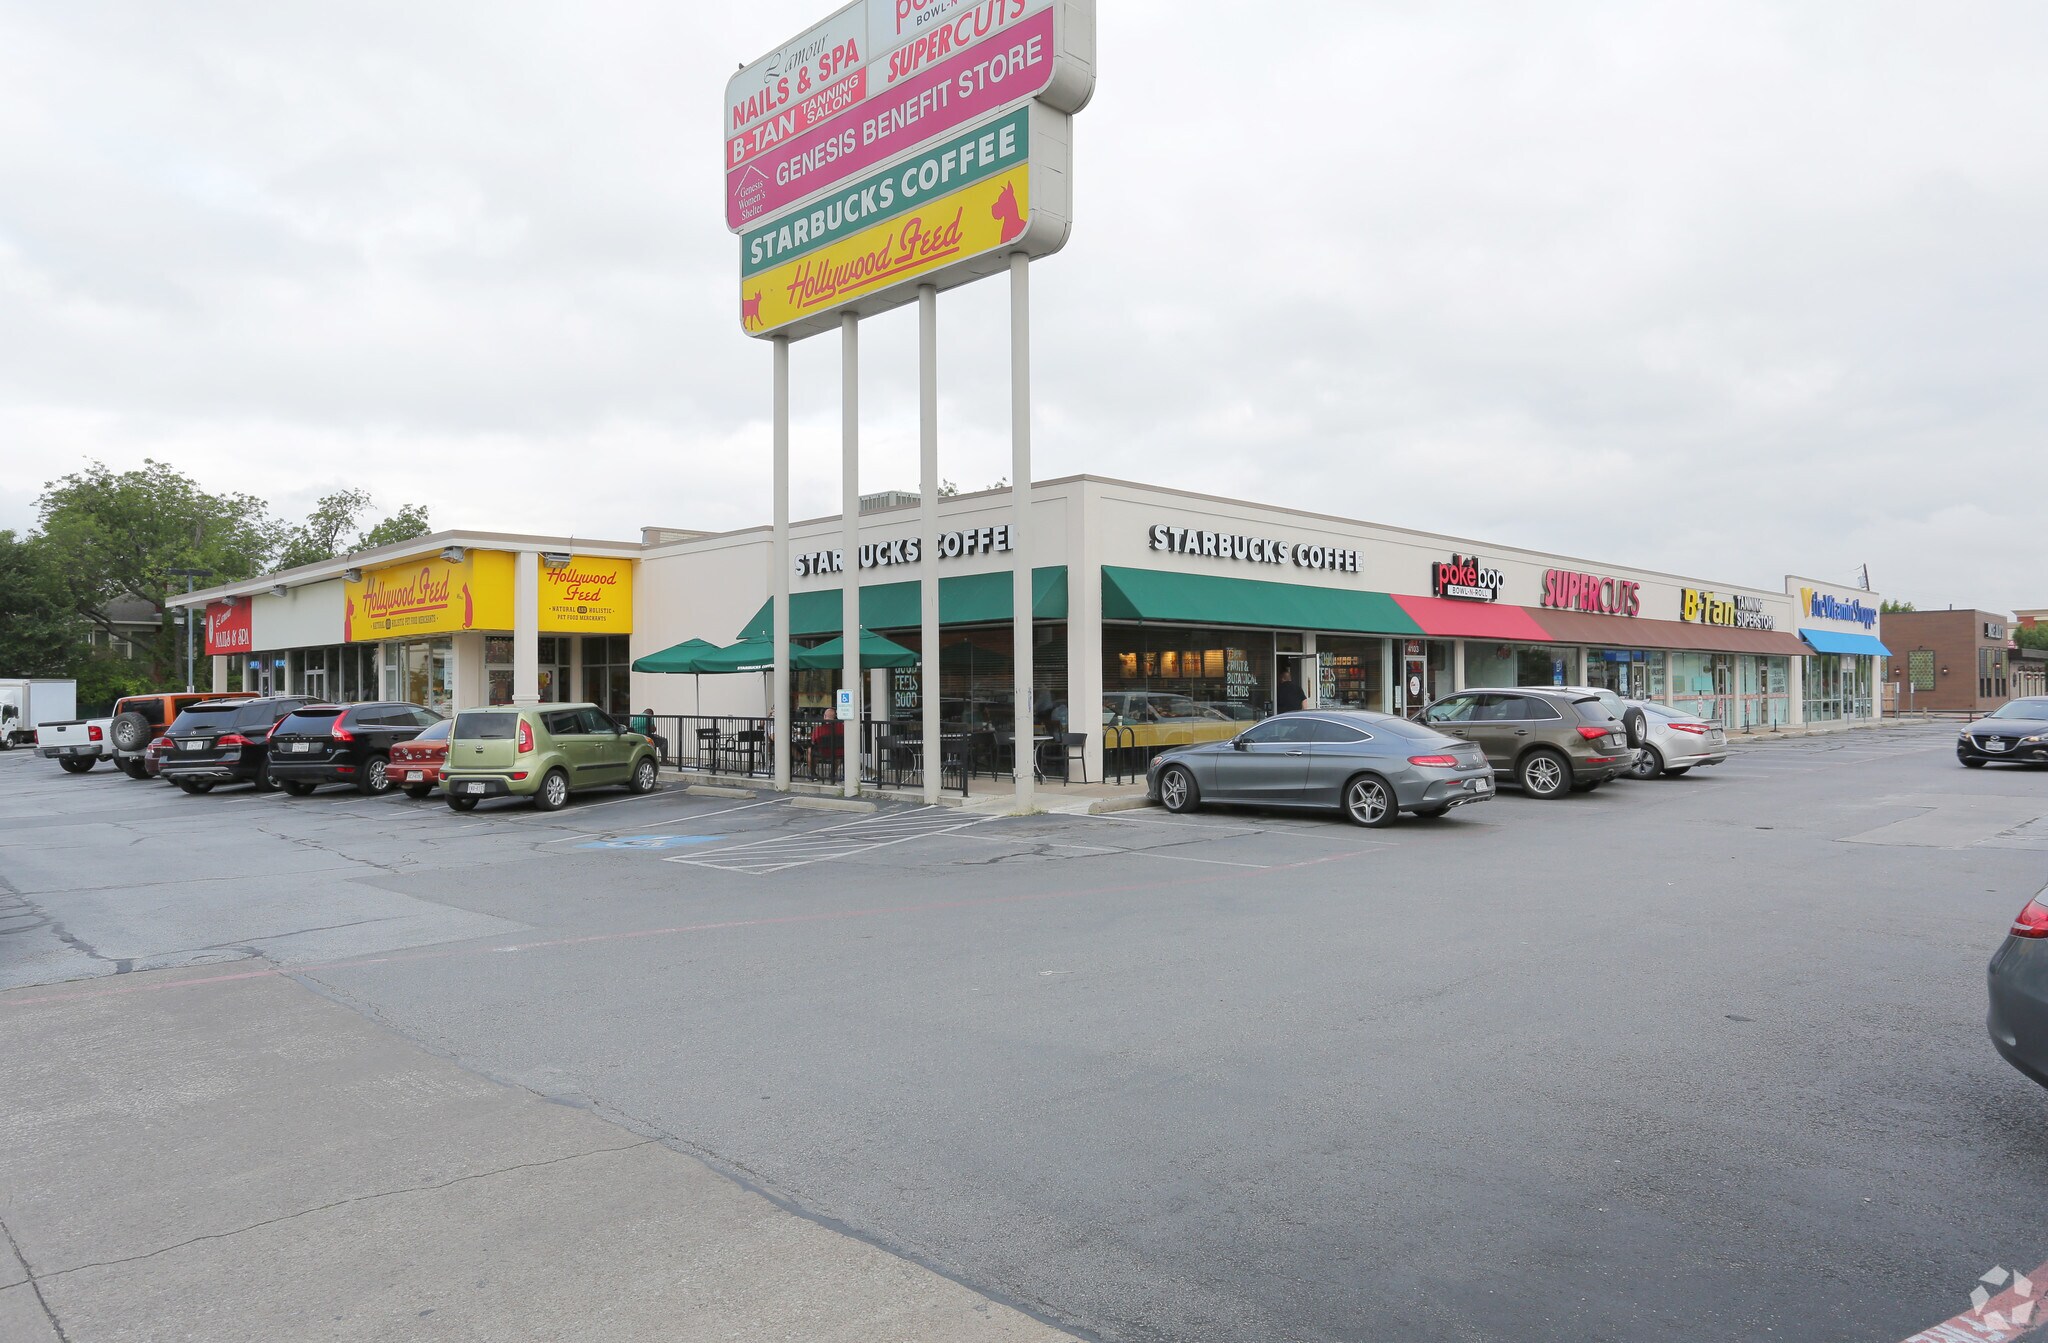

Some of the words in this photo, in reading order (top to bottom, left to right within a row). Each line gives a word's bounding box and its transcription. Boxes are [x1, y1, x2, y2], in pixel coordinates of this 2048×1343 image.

[888, 0, 1025, 83] SUPERCUTS
[733, 77, 789, 130] NAILS
[797, 66, 811, 94] &
[819, 38, 859, 81] SPA
[801, 75, 859, 114] TANNING
[776, 128, 856, 186] GENESIS
[863, 79, 951, 146] BENEFIT
[958, 34, 1042, 98] STORE
[807, 90, 852, 124] SALON
[733, 109, 795, 163] B-TAN
[738, 190, 766, 209] Women's
[740, 179, 764, 198] Genesis
[750, 178, 894, 264] STARBUCKS
[901, 123, 1016, 197] COFFEE
[741, 204, 763, 220] Shelter
[787, 233, 893, 309] Hollywood
[894, 206, 963, 264] Feed
[794, 537, 922, 577] STARUCKS
[1152, 524, 1290, 564] STARBUCKS
[1297, 543, 1365, 572] COFFEE
[363, 574, 416, 619] Hollywood
[416, 566, 450, 605] Feed
[546, 568, 617, 586] Hollywood
[563, 584, 602, 602] Feed
[1478, 557, 1505, 600] bop
[1544, 568, 1641, 617] SUPERCUTS
[552, 605, 576, 613] NATURAL
[1684, 588, 1736, 625] B-Tan
[1736, 612, 1776, 630] SUPERSTORE
[1737, 596, 1763, 612] TANNING
[895, 675, 919, 691] FEELS
[895, 691, 918, 708] GOOD
